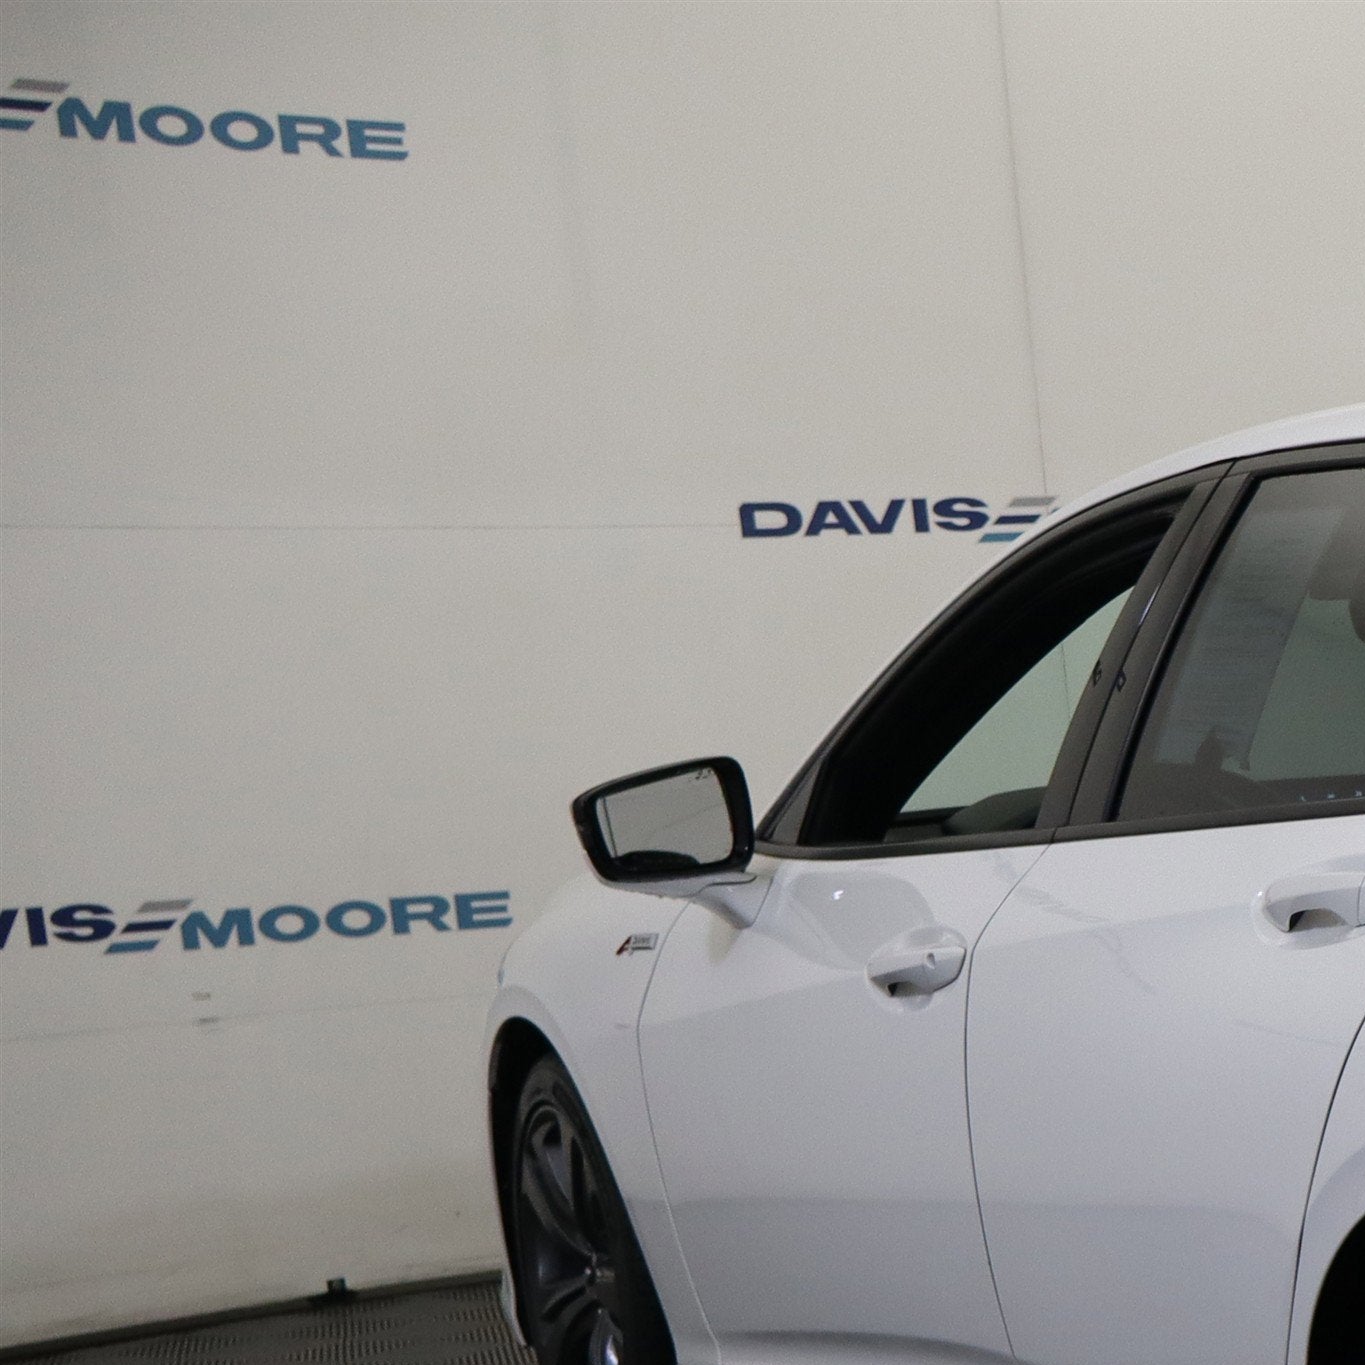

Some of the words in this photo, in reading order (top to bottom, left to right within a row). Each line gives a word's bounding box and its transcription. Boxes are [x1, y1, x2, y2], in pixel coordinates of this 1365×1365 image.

[57, 97, 409, 161] MOORE
[738, 497, 990, 539] DAVIS
[180, 890, 513, 951] MOORE
